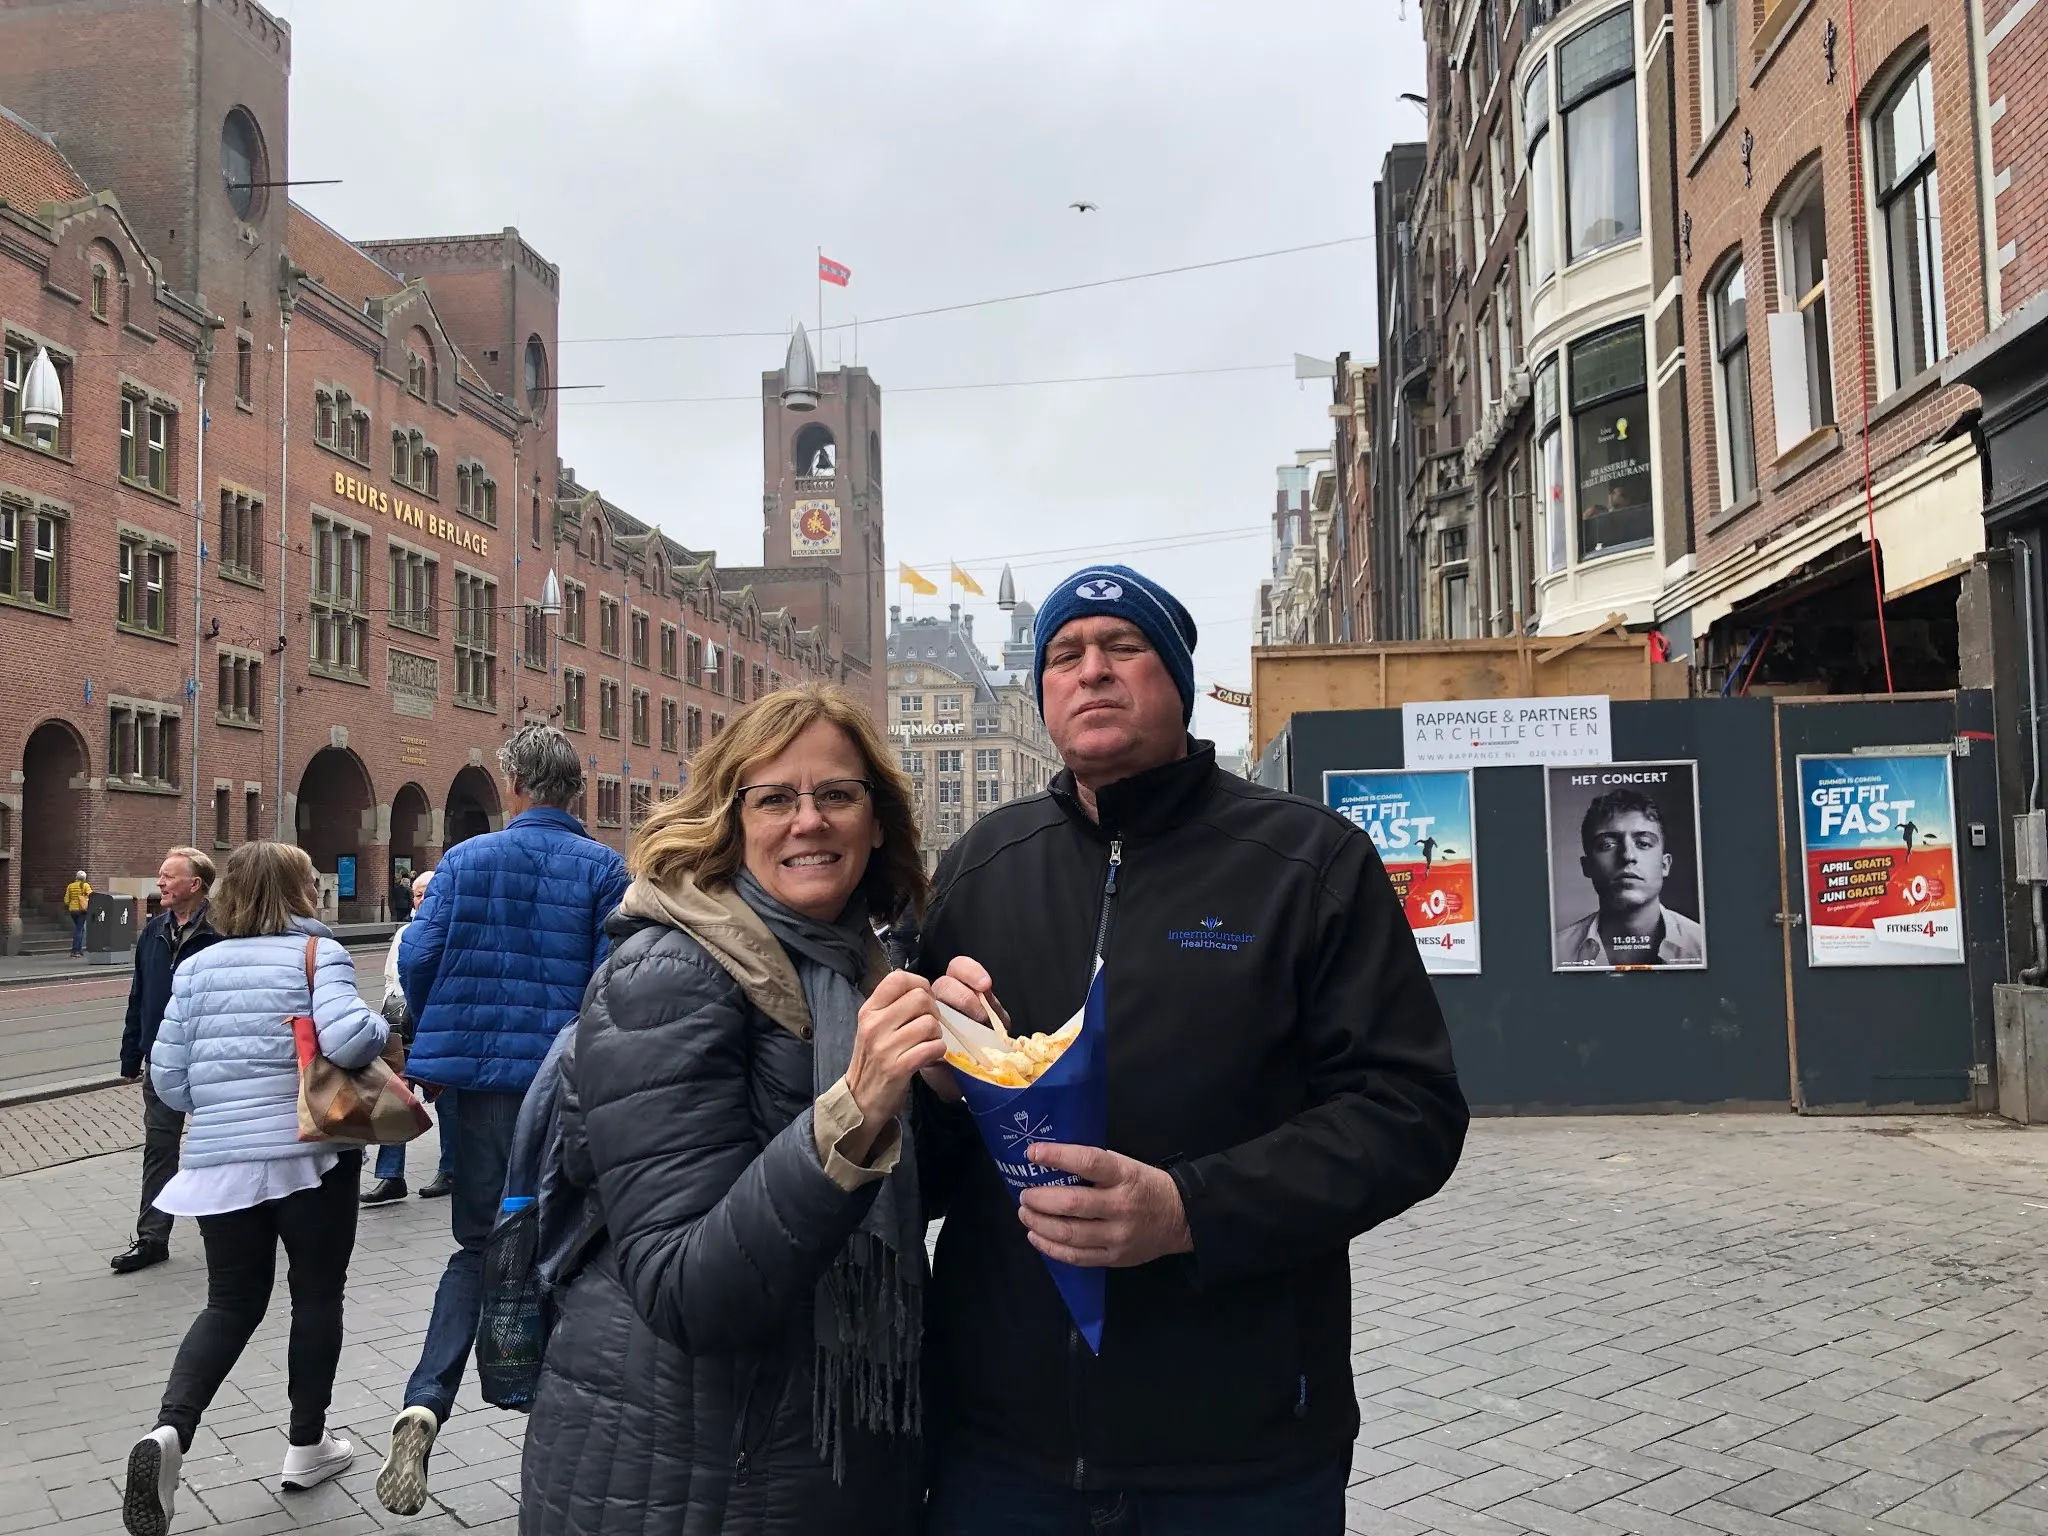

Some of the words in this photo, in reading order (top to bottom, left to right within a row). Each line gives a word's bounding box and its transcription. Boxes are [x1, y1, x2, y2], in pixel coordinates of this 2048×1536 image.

[1590, 460, 1628, 477] BRASSERIE
[1629, 458, 1636, 466] &
[1599, 463, 1650, 483] RESTAURANT
[335, 471, 388, 513] BEURS
[393, 497, 424, 530] VAN
[429, 513, 488, 557] BERLAGE
[1217, 689, 1252, 706] CASI
[1416, 710, 1498, 726] RAPPANGE
[1503, 709, 1515, 723] &
[1520, 707, 1598, 722] PARTNERS
[888, 723, 965, 735] IJENKORF
[1416, 723, 1598, 741] ARCHITECTEN
[1571, 775, 1597, 785] HET
[1602, 772, 1668, 785] CONCERT
[1854, 776, 1881, 784] COMING
[1376, 793, 1402, 801] COMING
[1811, 786, 1854, 806] GET
[1857, 784, 1889, 803] FIT
[1380, 801, 1410, 819] FIT
[1820, 800, 1915, 837] FAST
[1822, 861, 1853, 874] APRIL
[1854, 856, 1892, 870] GRATIS
[1390, 872, 1411, 881] ATIS
[1828, 876, 1848, 887] MEI
[1849, 871, 1888, 884] GRATIS
[1820, 891, 1846, 903] JUNI
[1847, 885, 1885, 899] GRATIS
[1903, 875, 1927, 907] 10
[1421, 889, 1446, 920] 10
[1168, 929, 1254, 942] Intermountain
[1415, 933, 1465, 949] NESS4me
[1613, 936, 1650, 944] 11.05.19
[1181, 939, 1238, 951] Healthcare
